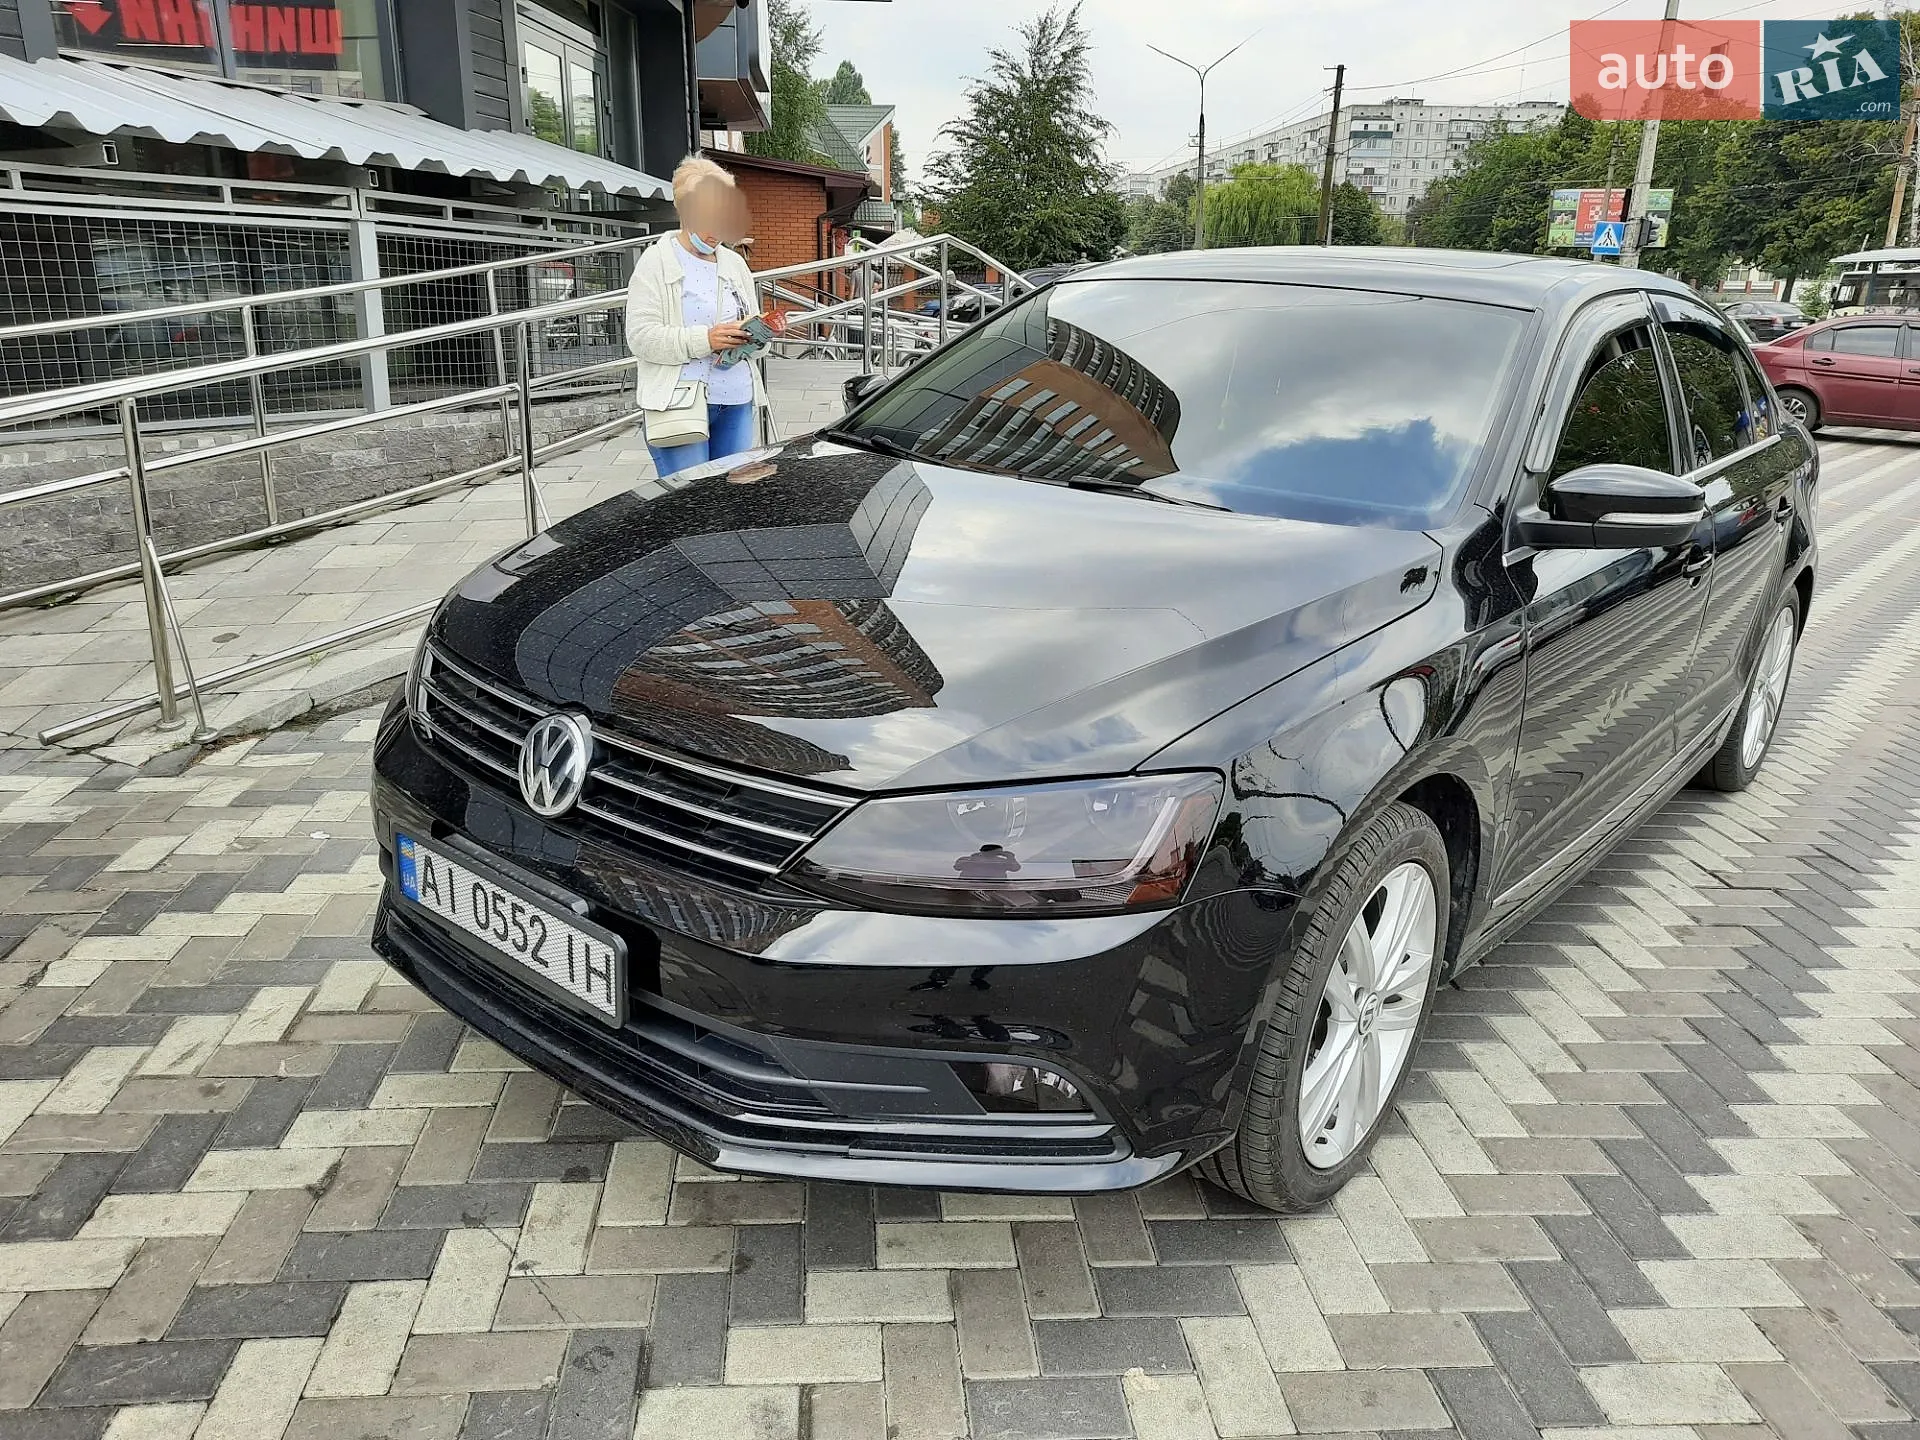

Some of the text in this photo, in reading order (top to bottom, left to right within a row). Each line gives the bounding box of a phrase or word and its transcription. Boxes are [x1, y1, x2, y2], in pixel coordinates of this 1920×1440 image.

[422, 855, 612, 1004] AI 0552 IH
